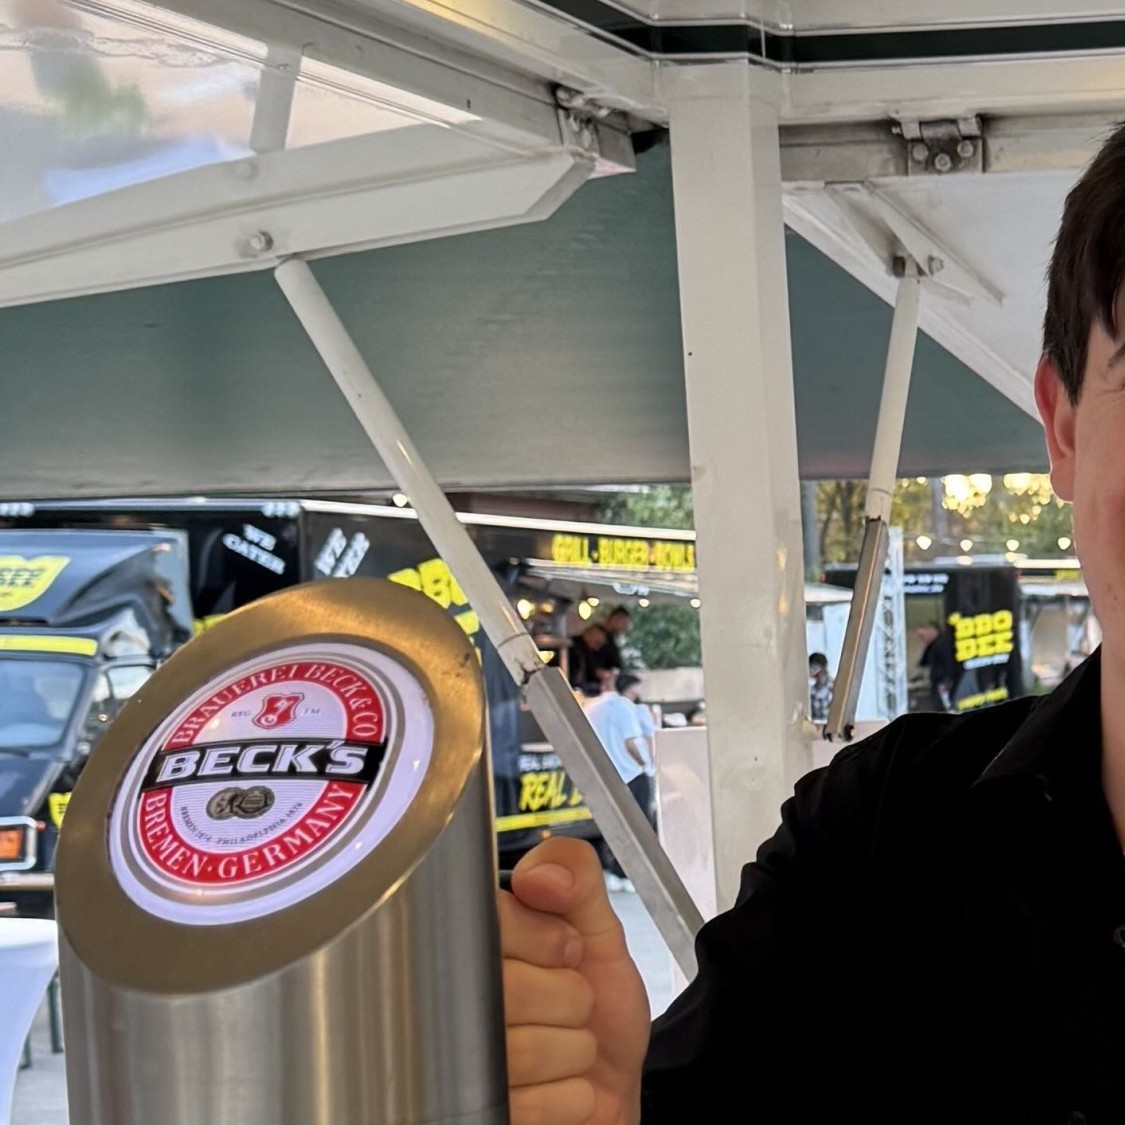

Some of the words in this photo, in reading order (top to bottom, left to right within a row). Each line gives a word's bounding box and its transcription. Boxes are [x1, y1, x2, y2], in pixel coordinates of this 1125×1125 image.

[172, 664, 297, 744] BRAUEREI
[303, 663, 368, 702] BECK
[156, 740, 369, 782] BECK'S
[145, 793, 207, 877] BREMEN
[217, 785, 354, 879] GERMANY
